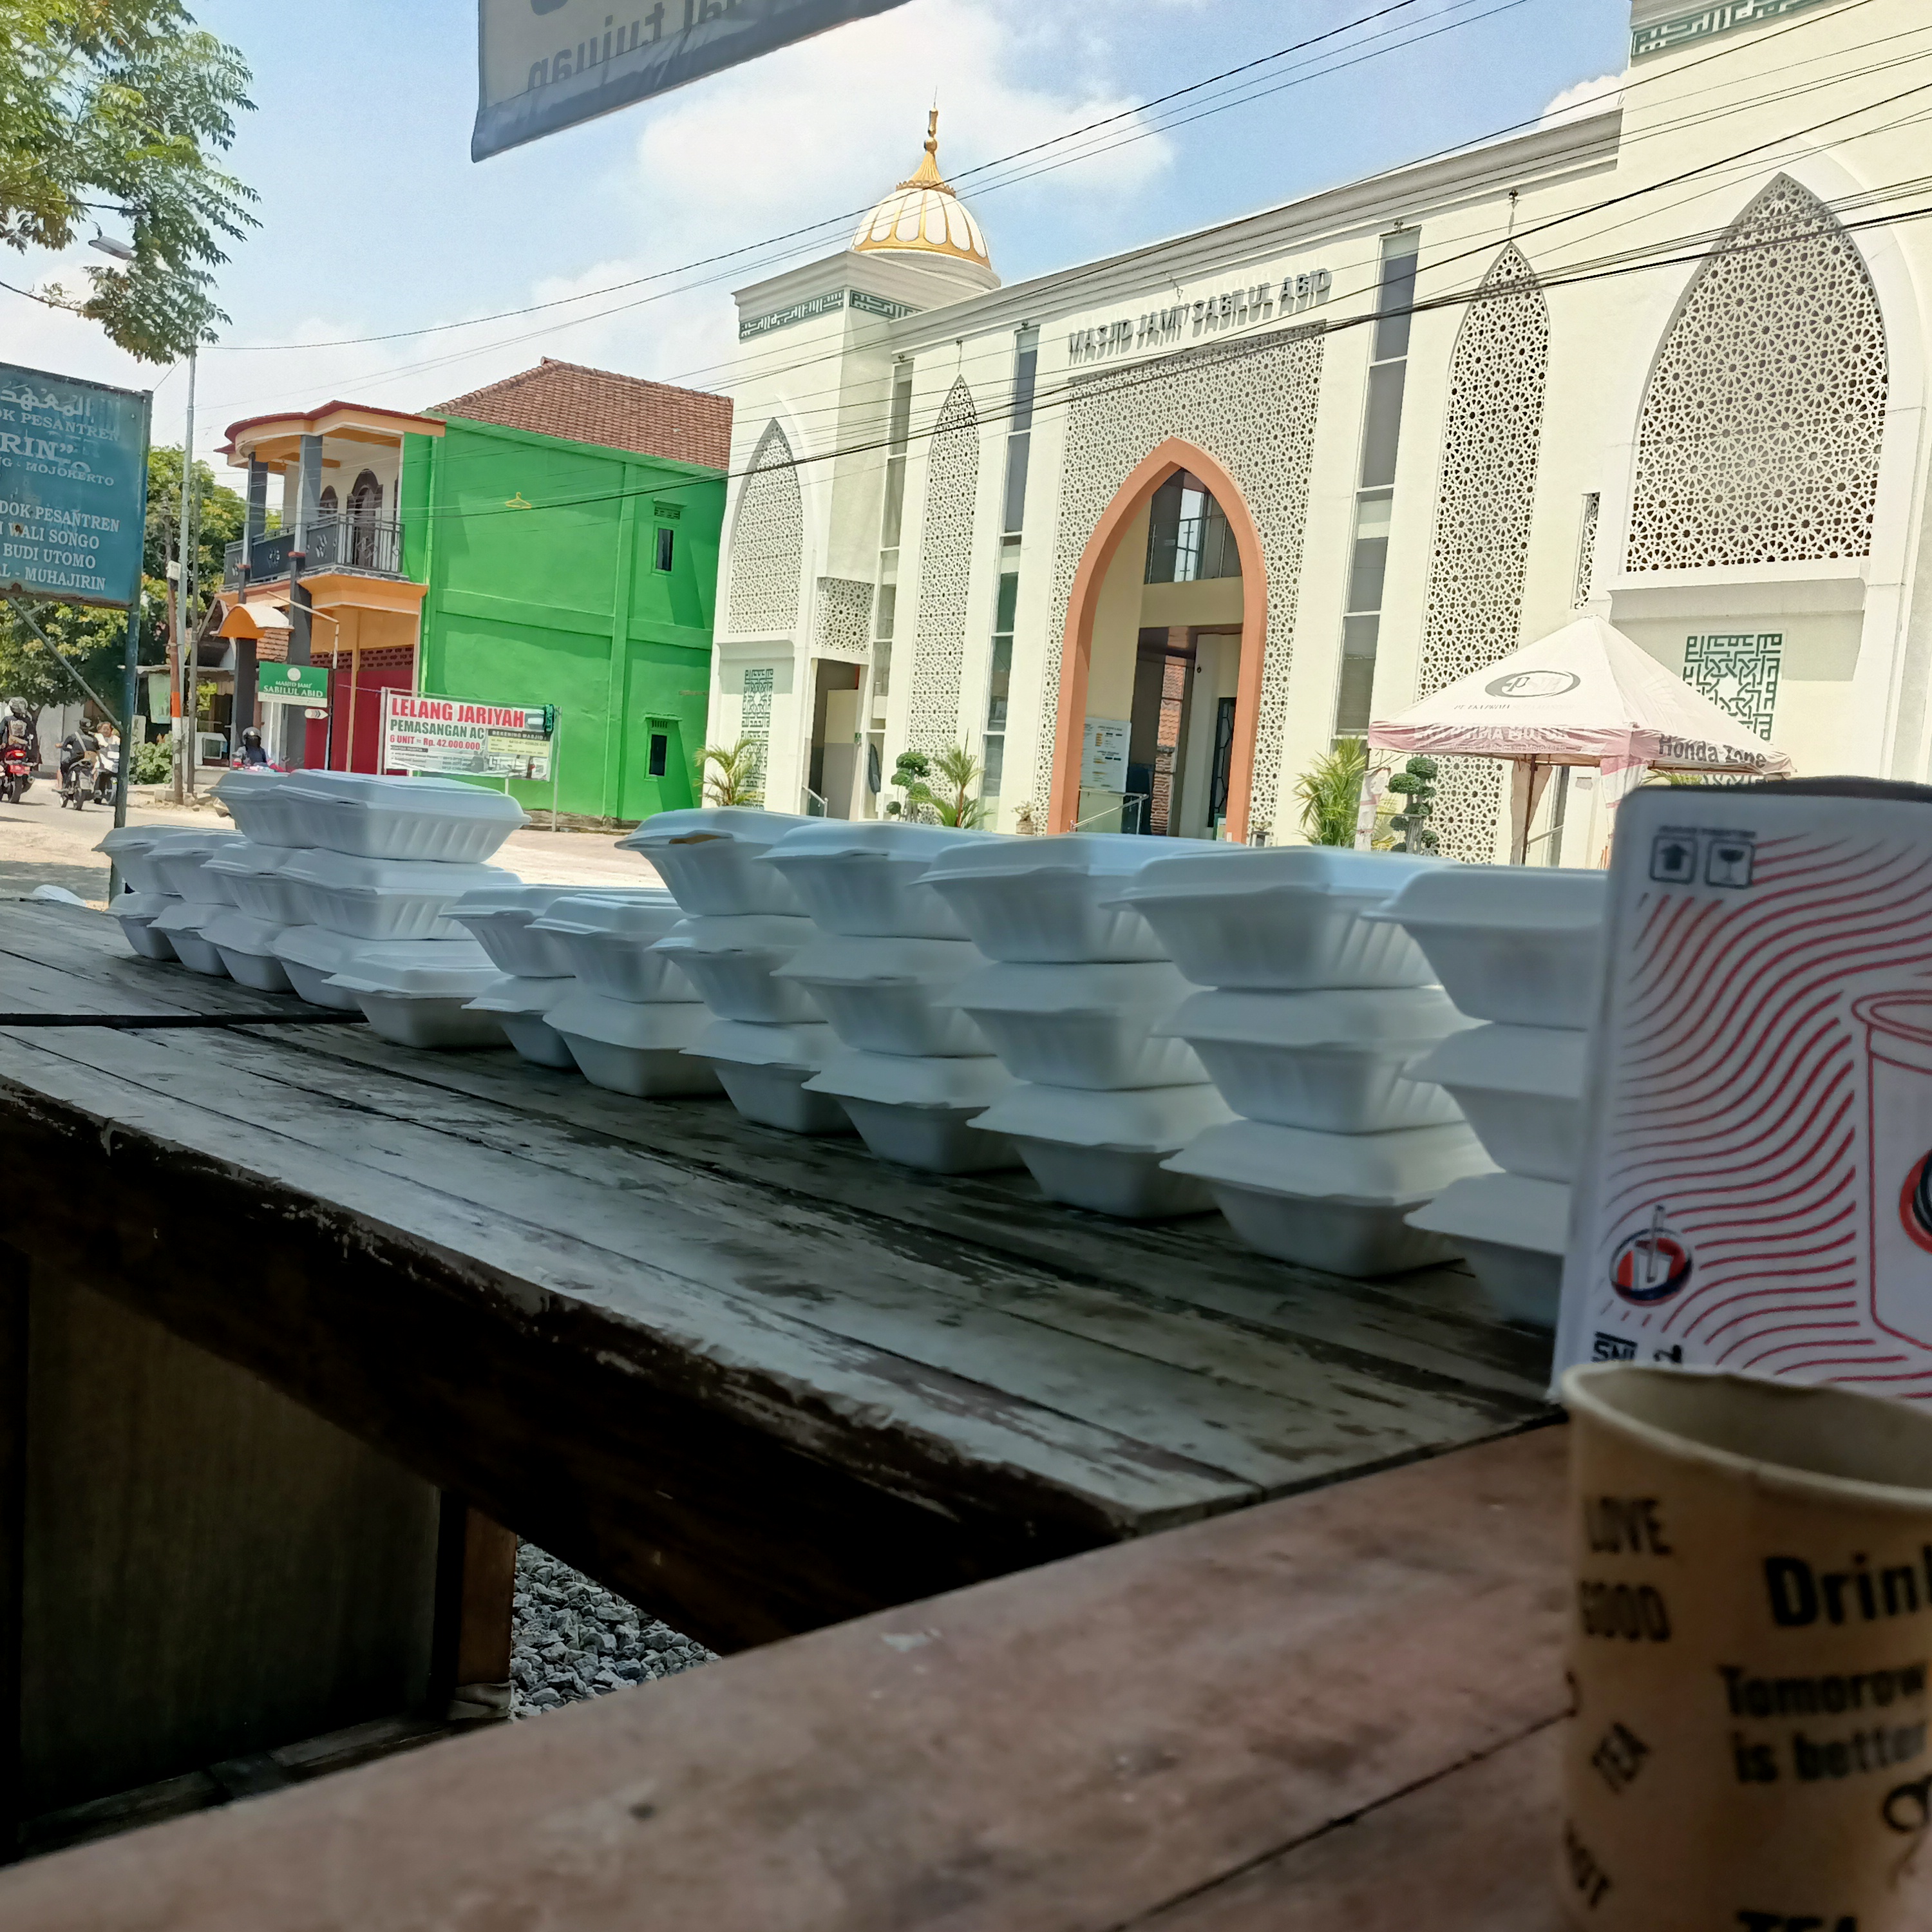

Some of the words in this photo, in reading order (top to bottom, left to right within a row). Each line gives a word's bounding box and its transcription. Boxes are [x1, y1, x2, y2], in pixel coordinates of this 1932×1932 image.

[1068, 319, 1134, 354] MASJID
[1192, 282, 1274, 325] SABILUL
[1278, 268, 1332, 303] ABID
[20, 412, 120, 441] PESANTREN
[26, 461, 115, 486] MOJOKERTO
[35, 506, 120, 533] PESANTREN
[8, 522, 44, 542] WALI
[49, 529, 100, 549] SONGO
[3, 543, 39, 561] BUDI
[43, 549, 96, 569] UTOMO
[24, 567, 106, 591] MUHAJIRIN
[263, 685, 300, 696] SABILUL
[392, 697, 453, 721] LELANG
[458, 705, 524, 728] JARIYAH
[390, 719, 467, 738] PEMASANGAN
[469, 727, 484, 740] AC
[390, 734, 395, 743] 6
[397, 735, 415, 744] UNIT
[1658, 732, 1719, 763] Honda
